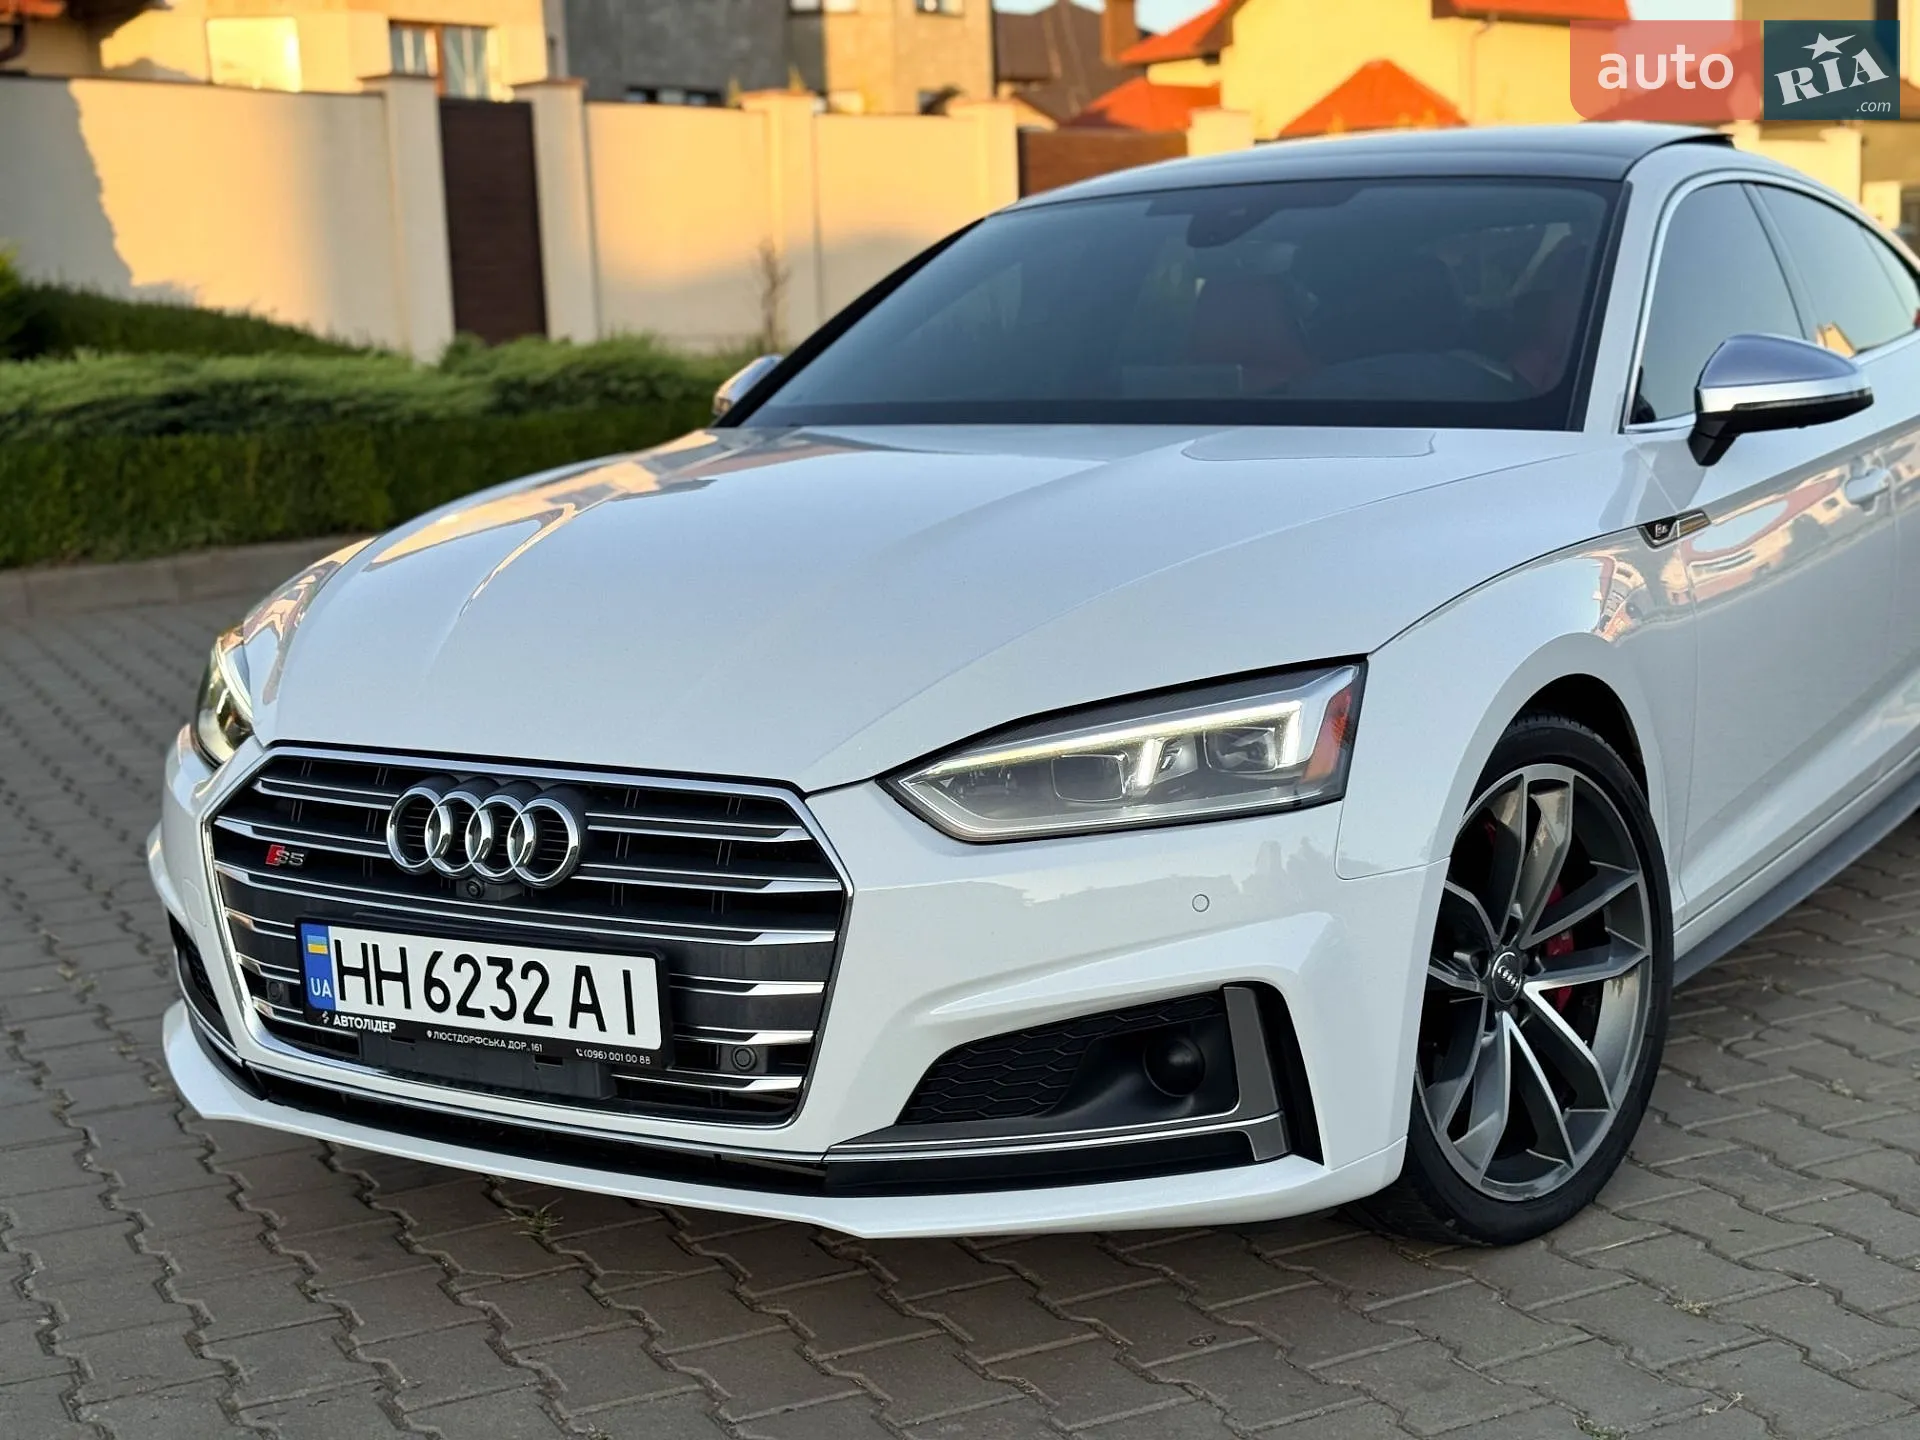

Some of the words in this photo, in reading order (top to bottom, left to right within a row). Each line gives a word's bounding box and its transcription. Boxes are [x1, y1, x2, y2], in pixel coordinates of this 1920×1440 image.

[274, 849, 305, 866] S5
[310, 977, 333, 998] UA
[334, 939, 412, 1010] HH
[424, 950, 554, 1027] 6232
[568, 965, 636, 1036] AI
[333, 1014, 397, 1033] АВТОЛІДЕР
[531, 1043, 543, 1053] 161
[583, 1049, 608, 1061] (096)
[608, 1051, 624, 1062] 001
[625, 1053, 637, 1063] 00
